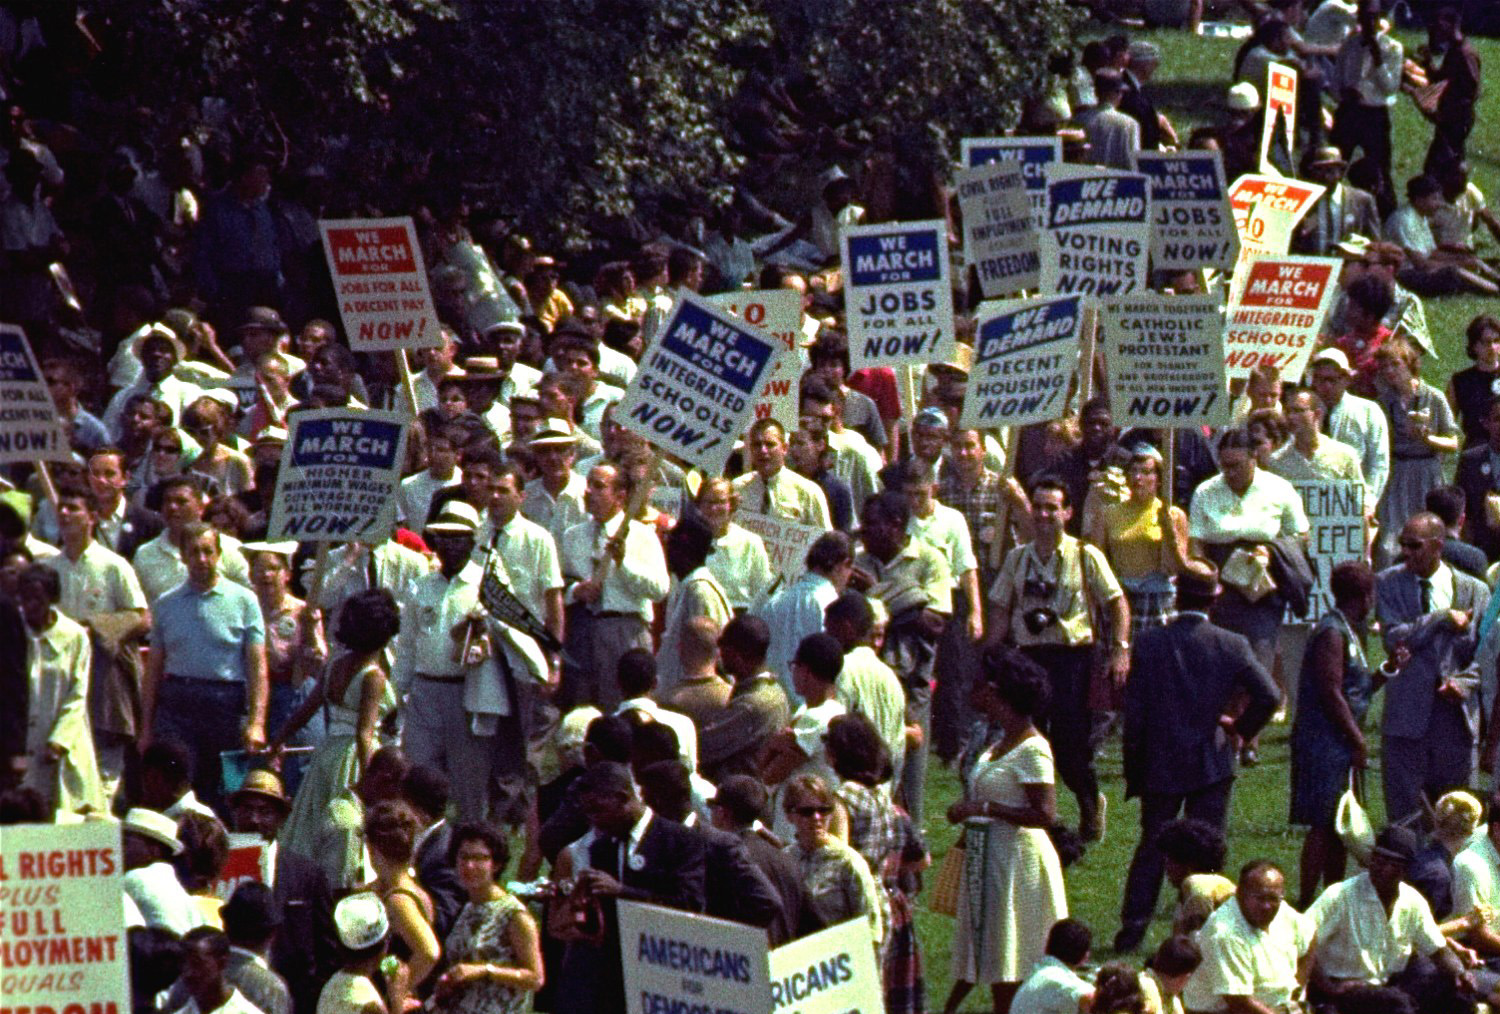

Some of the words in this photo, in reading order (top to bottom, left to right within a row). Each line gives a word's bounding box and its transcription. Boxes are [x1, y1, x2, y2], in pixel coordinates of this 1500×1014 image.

[1164, 161, 1190, 175] WE
[1080, 179, 1120, 199] WE
[1150, 173, 1216, 191] MARCH
[1053, 196, 1144, 225] DEMAND
[1155, 207, 1222, 226] JOBS
[355, 232, 381, 244] WE
[880, 235, 908, 252] WE
[1055, 230, 1142, 258] VOTING
[338, 245, 409, 263] MARCH
[856, 249, 934, 273] MARCH
[1162, 241, 1231, 262] NOW!
[1058, 254, 1137, 279] RIGHTS
[1278, 265, 1306, 280] WE
[1249, 279, 1322, 299] MARCH
[860, 289, 937, 316] JOBS
[359, 316, 427, 341] NOW!
[863, 317, 898, 330] FOR
[905, 314, 936, 327] ALL
[1011, 304, 1051, 332] WE
[1119, 318, 1204, 331] CATHOLIC
[1233, 311, 1316, 329] INTEGRATED
[709, 319, 741, 349] WE
[863, 327, 943, 360] NOW!
[982, 316, 1075, 358] DEMAND
[1136, 331, 1187, 344] JEWS
[1227, 329, 1308, 349] SCHOOLS
[672, 321, 758, 380] MARCH
[1117, 343, 1211, 356] PROTESTANT
[988, 353, 1063, 376] DECENT
[649, 351, 746, 413] INTEGRATED
[975, 374, 1065, 398] HOUSING
[639, 374, 735, 435] SCHOOLS
[978, 390, 1060, 420] NOW!
[1127, 391, 1218, 417] NOW!
[331, 420, 363, 434] WE
[630, 401, 723, 455] NOW!
[300, 436, 390, 456] MARCH
[281, 514, 377, 537] NOW!
[19, 847, 117, 881] RIGHTS
[0, 933, 119, 969] LOYMENT
[637, 931, 752, 985] AMERICANS
[0, 970, 86, 996] QUALS
[770, 951, 854, 1009] RICANS
